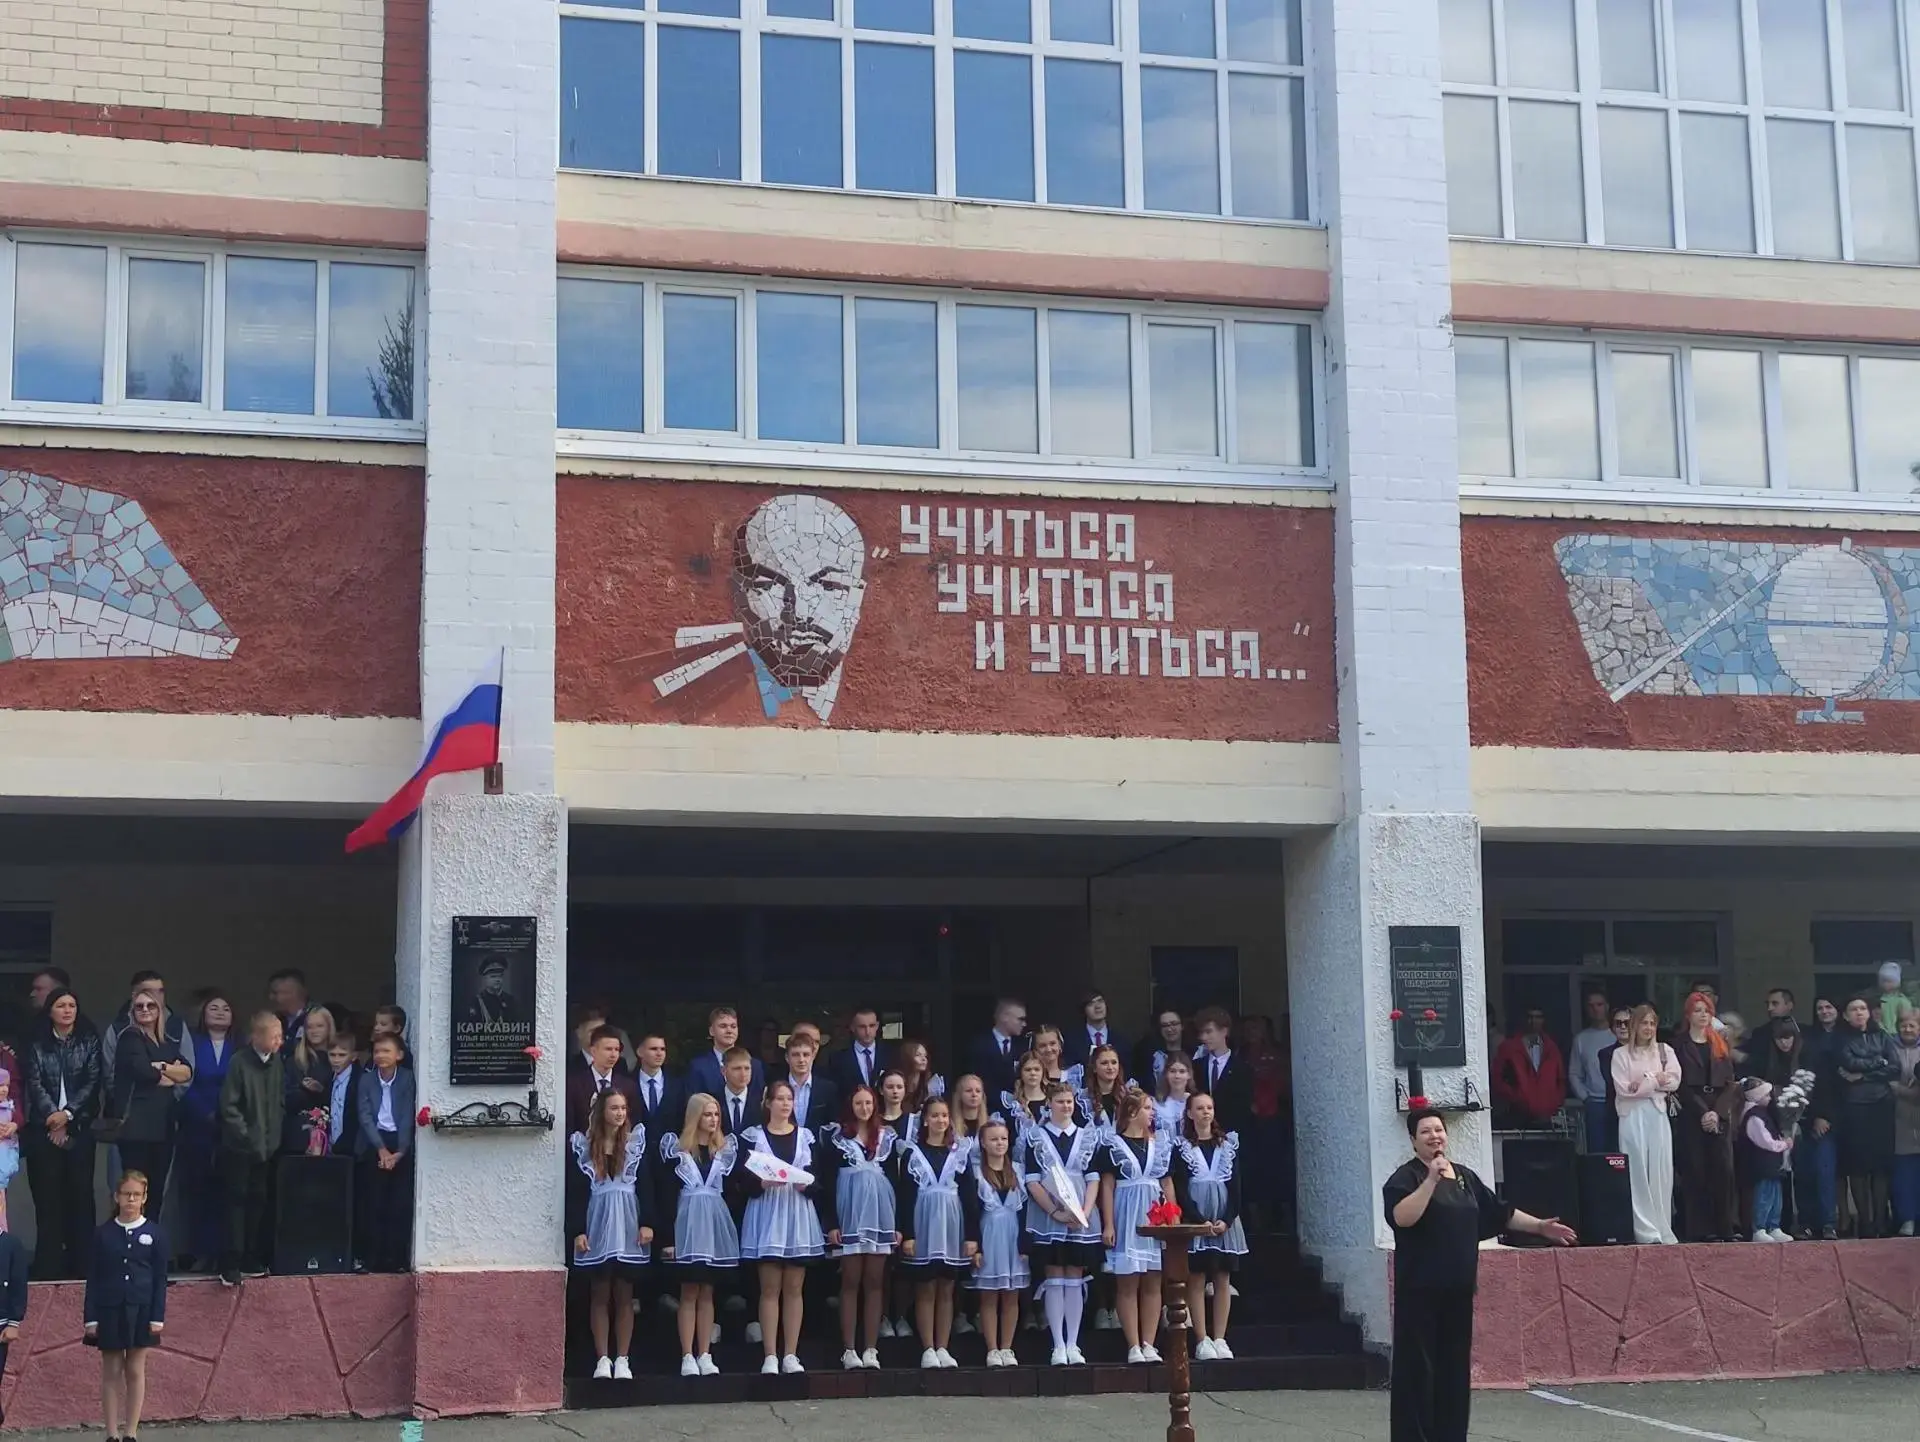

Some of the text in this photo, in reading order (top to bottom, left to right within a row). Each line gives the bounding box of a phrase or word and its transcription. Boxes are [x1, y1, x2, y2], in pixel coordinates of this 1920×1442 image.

[937, 564, 1174, 622] УЧИТЬСЯ
[975, 621, 1005, 671] И
[457, 1022, 531, 1033] КАРКАВИН
